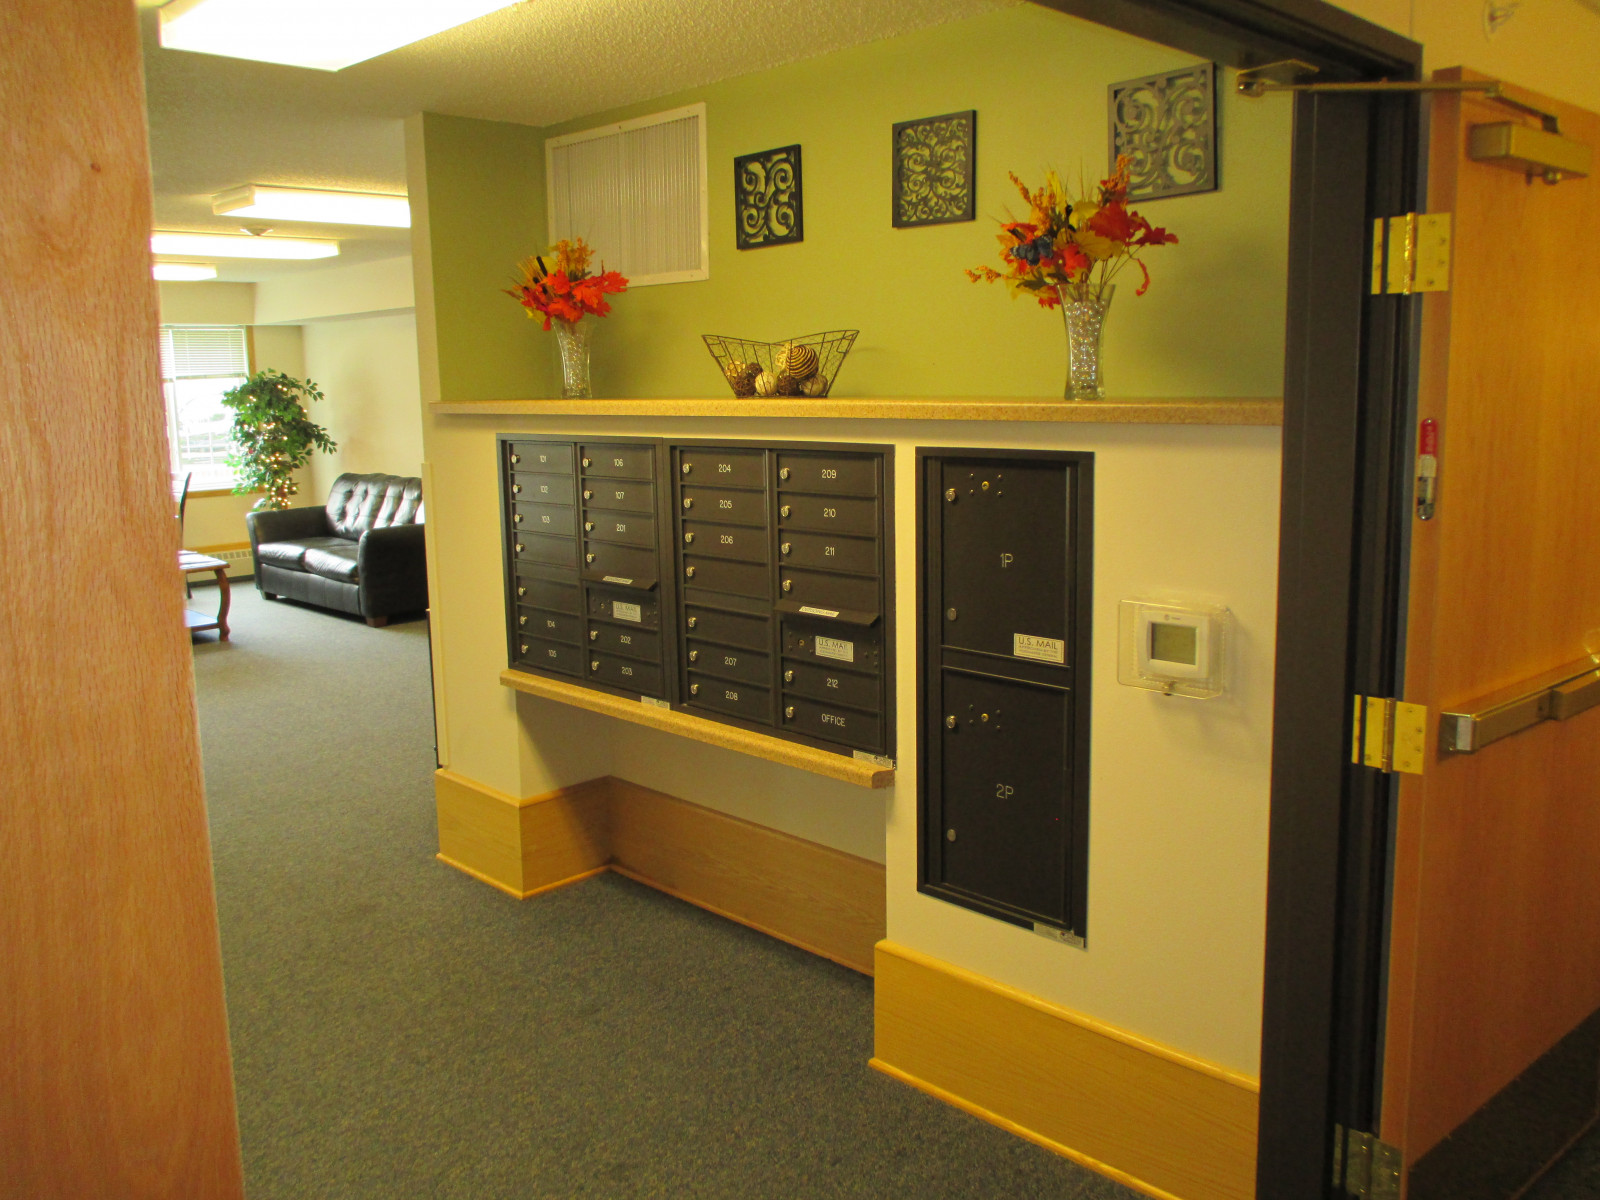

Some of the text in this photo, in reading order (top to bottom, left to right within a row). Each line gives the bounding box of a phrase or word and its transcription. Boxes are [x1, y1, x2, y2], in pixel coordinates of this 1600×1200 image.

[539, 455, 547, 463] 101
[613, 458, 624, 467] 106
[718, 464, 732, 473] 204
[821, 469, 836, 479] 209
[540, 485, 549, 494] 102
[615, 491, 625, 500] 107
[719, 499, 733, 509] 205
[823, 508, 836, 518] 210
[541, 515, 551, 524] 103
[616, 523, 626, 532] 201
[720, 535, 734, 544] 206
[824, 547, 835, 557] 211
[1000, 553, 1013, 568] 1P
[546, 619, 556, 629] 104
[620, 635, 632, 645] 202
[1018, 636, 1057, 650] U.S. MAIL
[548, 649, 557, 658] 105
[724, 656, 737, 667] 207
[621, 666, 633, 676] 203
[826, 677, 839, 689] 212
[725, 690, 738, 701] 208
[821, 713, 846, 727] OFFICE
[996, 783, 1014, 800] 2P
